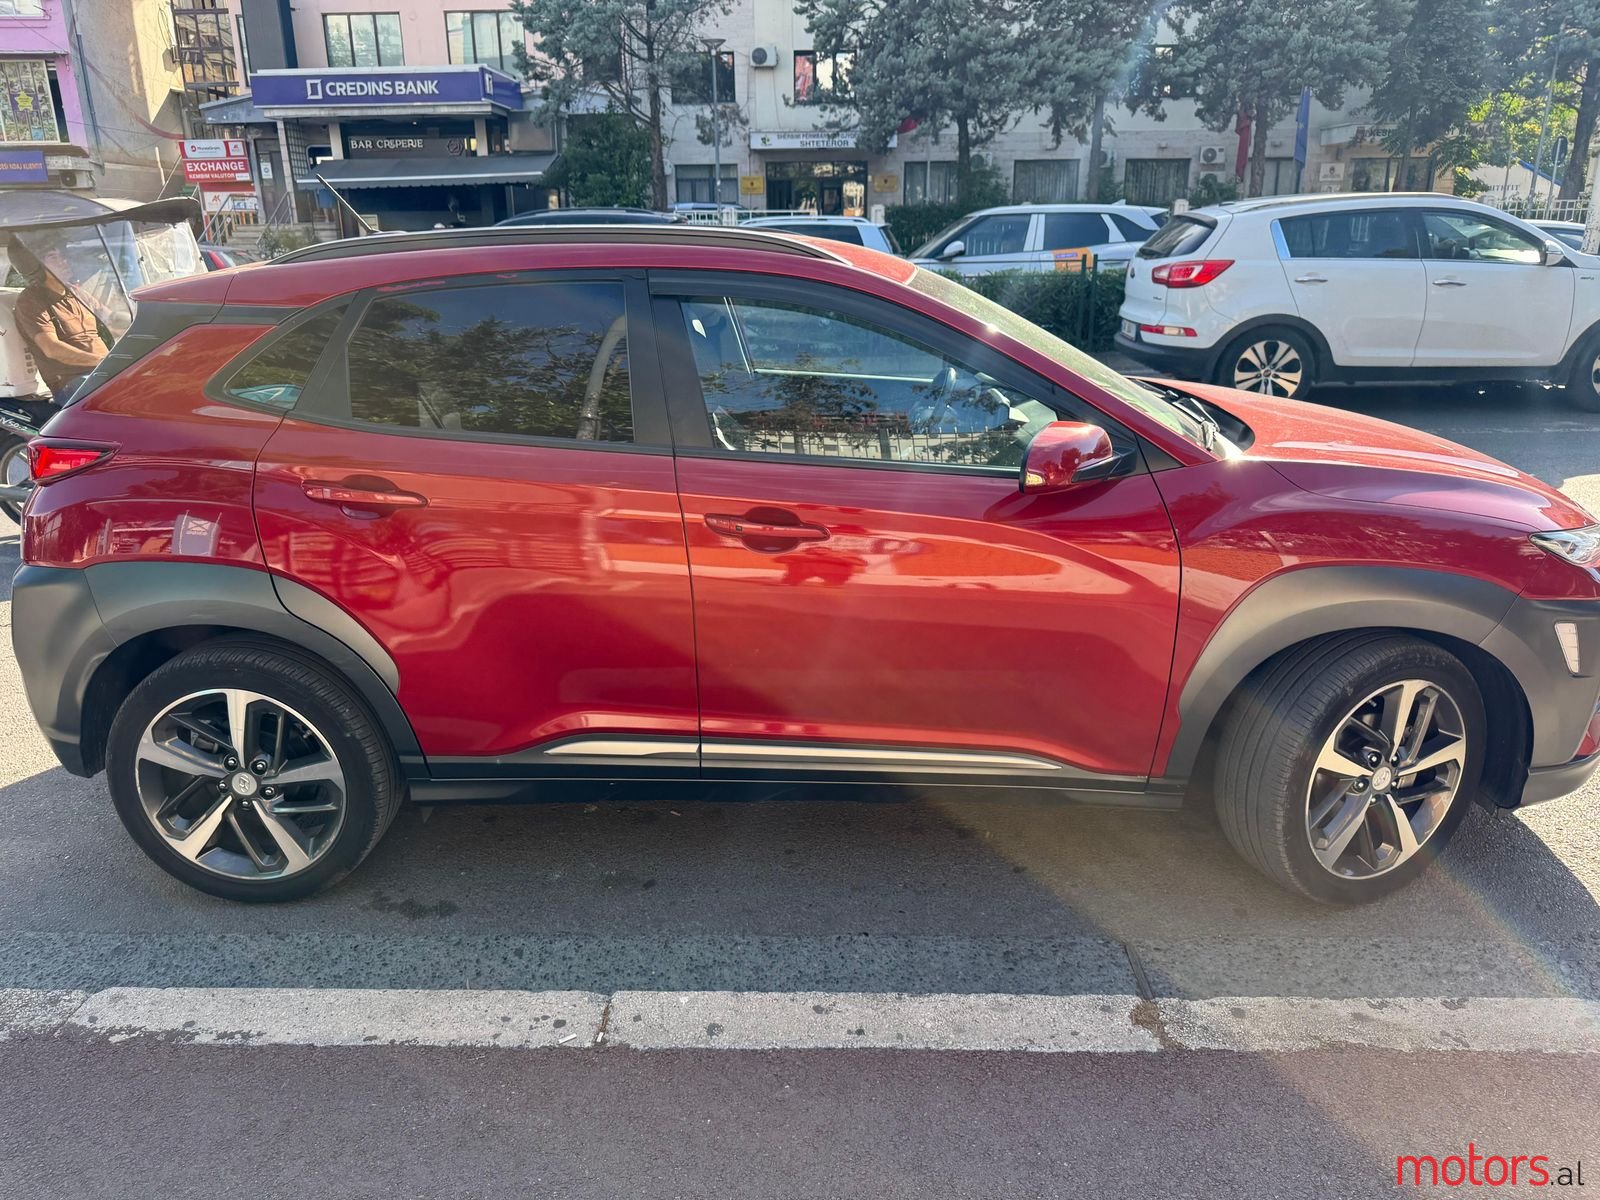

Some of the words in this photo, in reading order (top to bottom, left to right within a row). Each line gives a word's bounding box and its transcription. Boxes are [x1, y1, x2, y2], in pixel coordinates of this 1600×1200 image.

[325, 81, 392, 96] CREDINS
[395, 80, 439, 95] BANK
[351, 140, 373, 149] BAR
[186, 161, 246, 172] EXCHANGE
